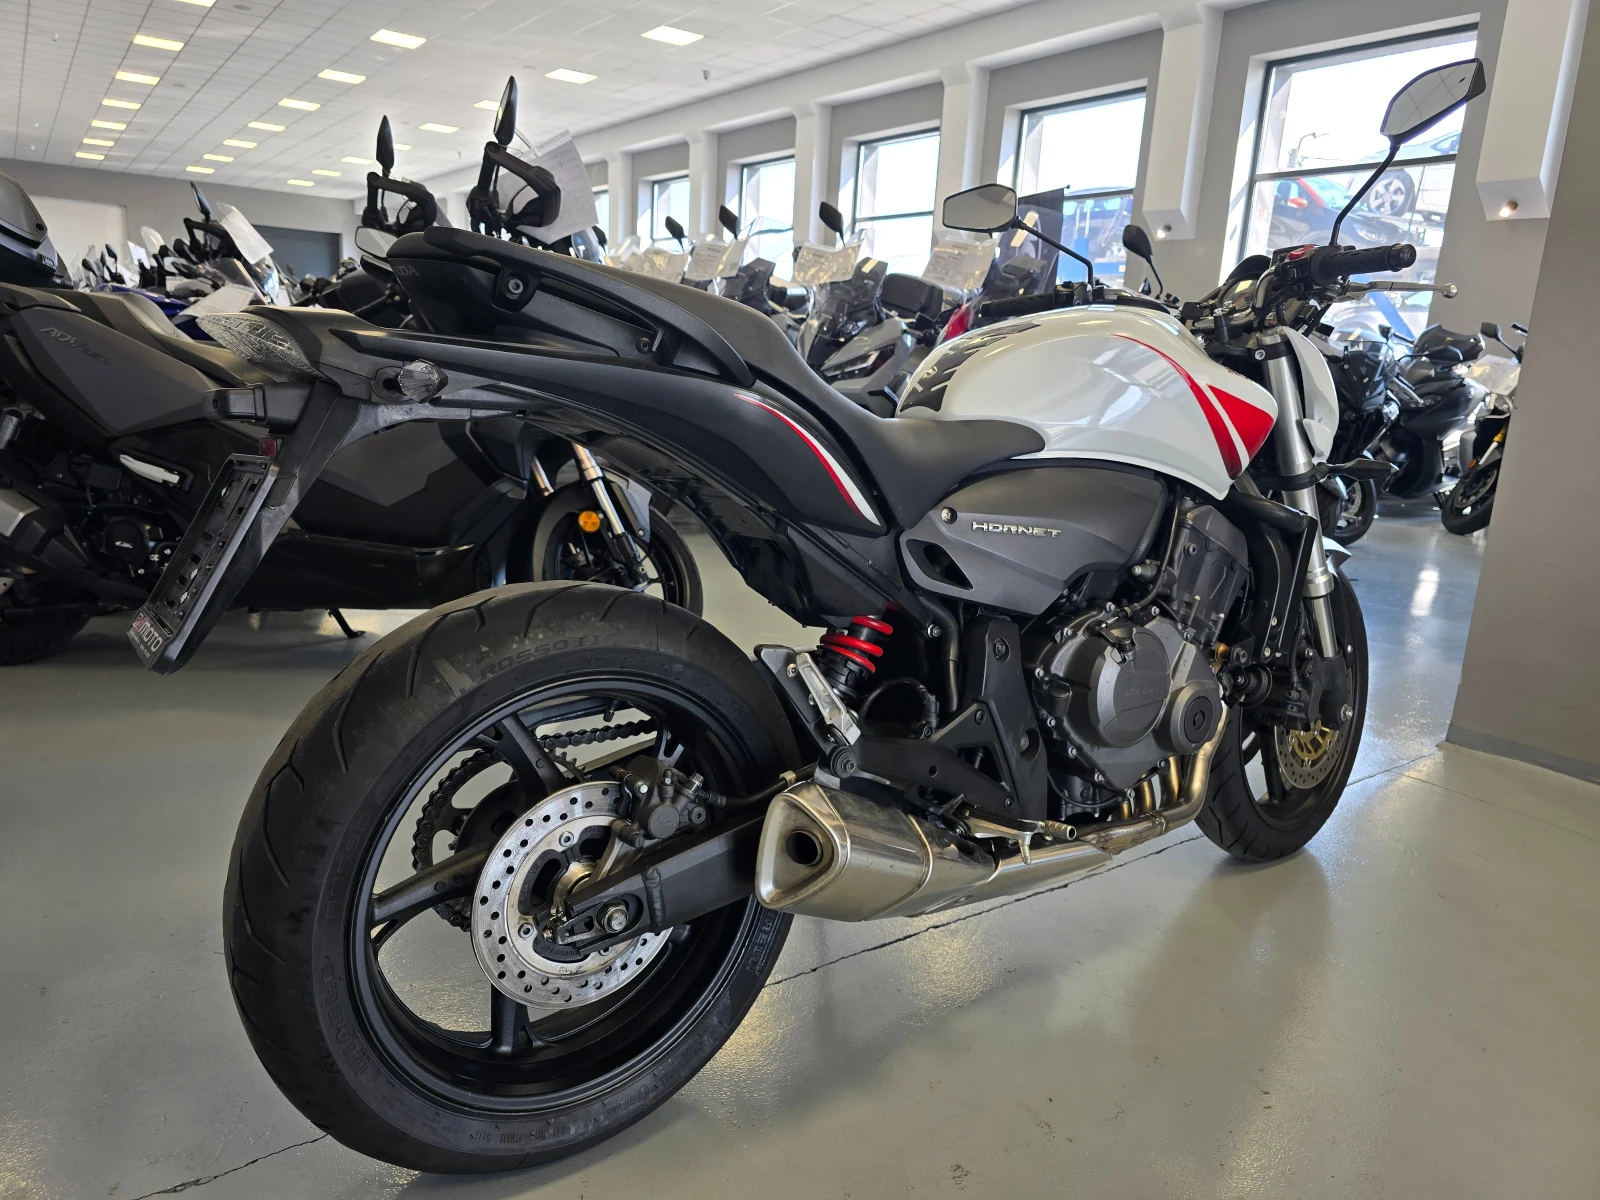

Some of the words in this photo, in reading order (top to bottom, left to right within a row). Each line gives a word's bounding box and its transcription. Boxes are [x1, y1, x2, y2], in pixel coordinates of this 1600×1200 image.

[971, 520, 1063, 539] HORNET
[479, 639, 569, 680] ROSSO
[324, 813, 371, 921] ROSSO
[321, 962, 369, 1077] DIABLO
